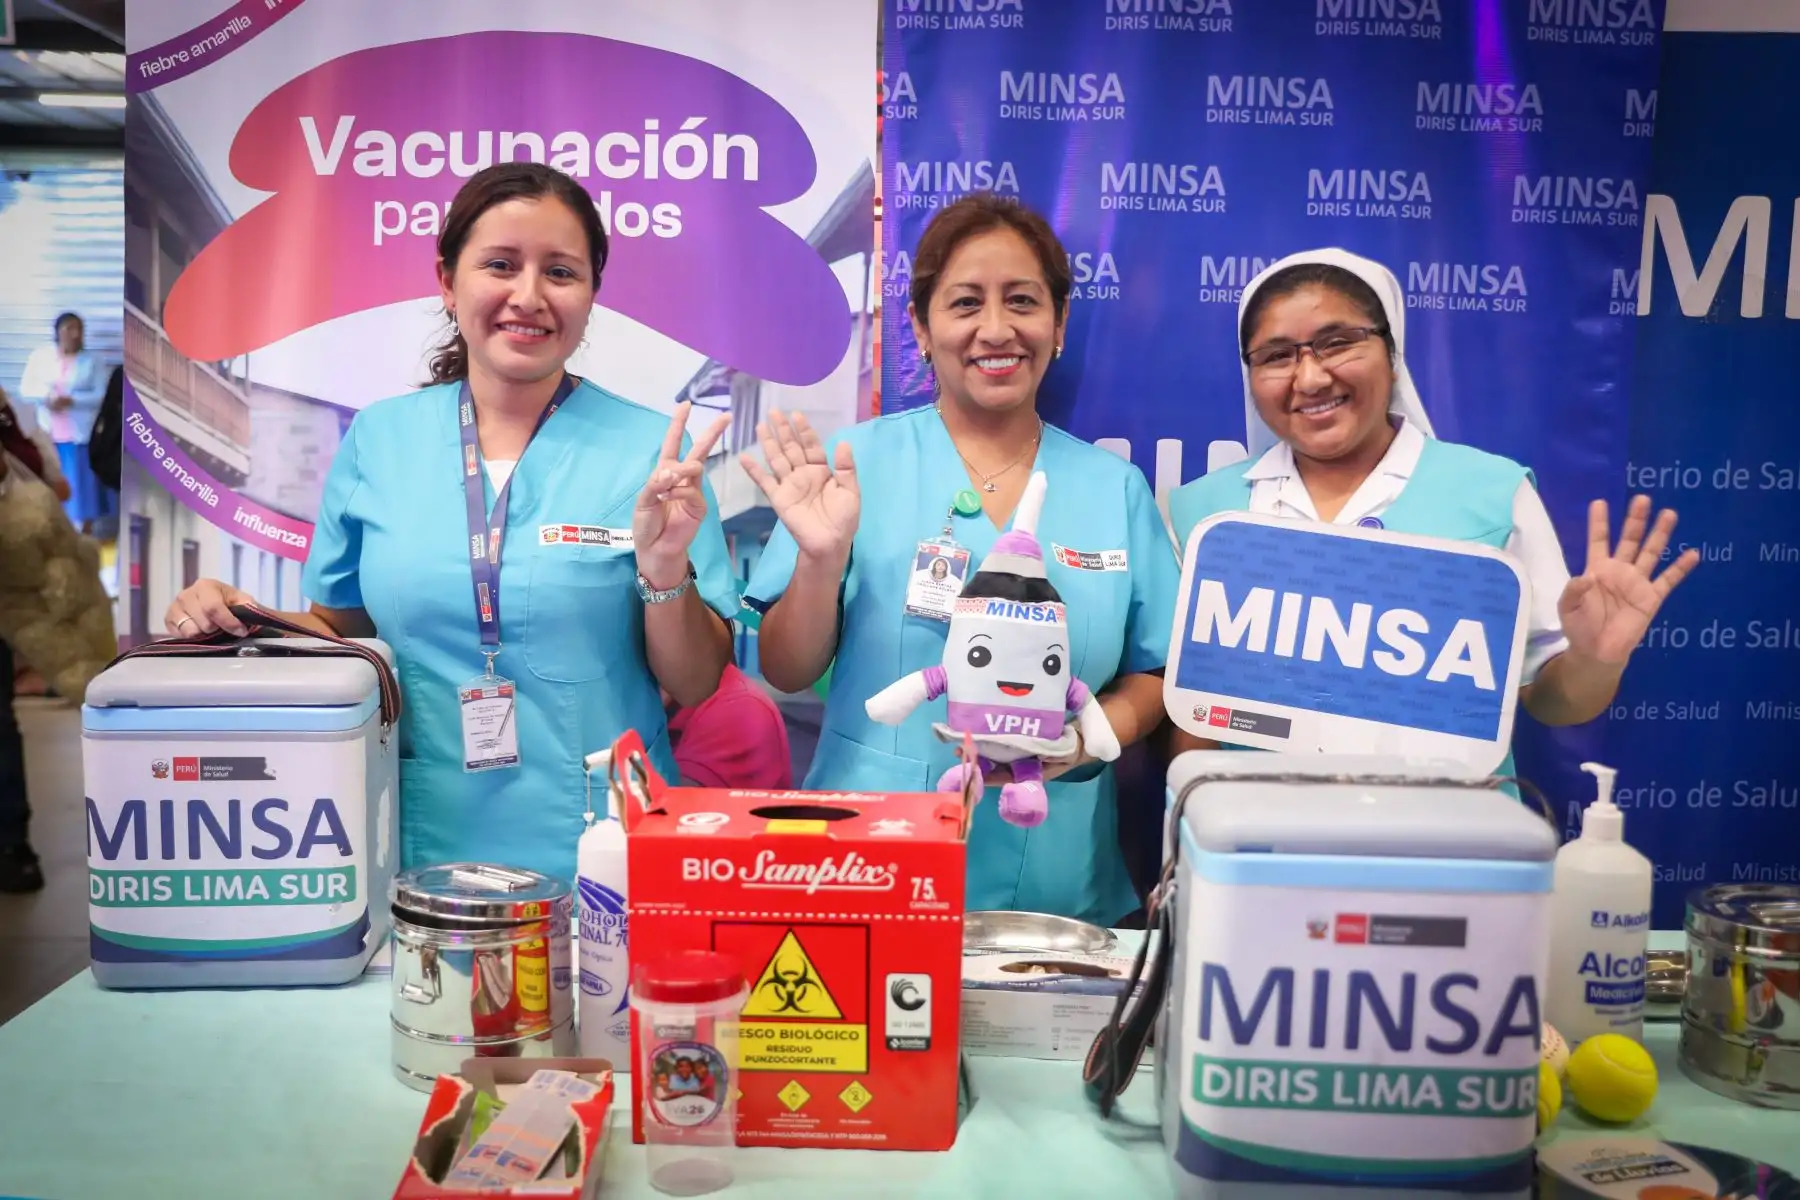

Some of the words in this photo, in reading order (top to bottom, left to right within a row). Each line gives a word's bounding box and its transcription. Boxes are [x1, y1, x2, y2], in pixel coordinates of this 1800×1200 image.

[896, 14, 940, 29] DIRIS
[944, 14, 986, 30] LIMA
[990, 14, 1024, 29] SUR
[1105, 15, 1149, 30] DIRIS
[1154, 15, 1195, 31] LIMA
[1198, 18, 1233, 32] SUR
[1315, 21, 1360, 36] DIRIS
[1365, 22, 1406, 37] LIMA
[1410, 23, 1442, 40] SUR
[139, 50, 190, 78] fiebre
[191, 15, 252, 58] amarilla
[1527, 26, 1569, 43] DIRIS
[1573, 29, 1616, 44] LIMA
[1620, 31, 1656, 46] SUR
[1000, 70, 1126, 104] MINSA
[1206, 75, 1334, 111] MINSA
[1416, 81, 1544, 116] MINSA
[886, 105, 918, 119] SUR
[1000, 104, 1042, 120] DIRIS
[1046, 107, 1088, 121] LIMA
[1092, 106, 1126, 120] SUR
[1206, 109, 1250, 124] DIRIS
[1254, 110, 1296, 126] LIMA
[1299, 111, 1334, 126] SUR
[1415, 115, 1456, 131] DIRIS
[1460, 117, 1503, 132] LIMA
[1507, 117, 1544, 132] SUR
[298, 115, 759, 181] Vacunación
[895, 161, 1020, 193] MINSA
[1101, 162, 1226, 197] MINSA
[1307, 168, 1431, 203] MINSA
[894, 195, 938, 209] DIRIS
[1512, 174, 1639, 210] MINSA
[1100, 196, 1144, 210] DIRIS
[1148, 198, 1188, 213] LIMA
[1192, 199, 1226, 213] SUR
[1306, 202, 1351, 217] DIRIS
[1355, 203, 1398, 218] LIMA
[1401, 204, 1432, 220] SUR
[1511, 209, 1557, 224] DIRIS
[1562, 210, 1603, 227] LIMA
[1607, 212, 1638, 227] SUR
[1407, 261, 1528, 296] MINSA
[1086, 286, 1120, 300] SUR
[1407, 295, 1445, 309] DIRIS
[1449, 296, 1488, 311] LIMA
[1492, 298, 1527, 313] SUR
[126, 412, 166, 459] fiebre
[162, 456, 220, 509] amarilla
[232, 506, 307, 549] influenza
[1712, 459, 1750, 489] de
[581, 530, 610, 542] MINSA
[985, 602, 1058, 623] MINSA
[1191, 579, 1496, 691] MINSA
[1632, 621, 1689, 648] rio
[1700, 619, 1736, 648] de
[1634, 701, 1658, 720] de
[1664, 700, 1720, 720] Salud
[984, 713, 1041, 736] VPH
[176, 763, 197, 773] PERÚ
[1612, 781, 1676, 808] erio
[1686, 780, 1723, 808] de
[85, 796, 354, 861] MINSA
[682, 857, 734, 881] BIO
[89, 875, 173, 902] DIRIS
[184, 875, 270, 902] LIMA
[280, 873, 349, 899] SUR
[1198, 962, 1541, 1057] MINSA
[721, 1027, 776, 1040] ESGO
[779, 1028, 860, 1041] BIOLÓGICO
[766, 1044, 813, 1054] RESIDUO
[744, 1055, 837, 1066] PUNZOCORTANTE
[1201, 1063, 1319, 1104] DIRIS
[1332, 1069, 1444, 1109] LIMA
[1455, 1075, 1537, 1111] SUR
